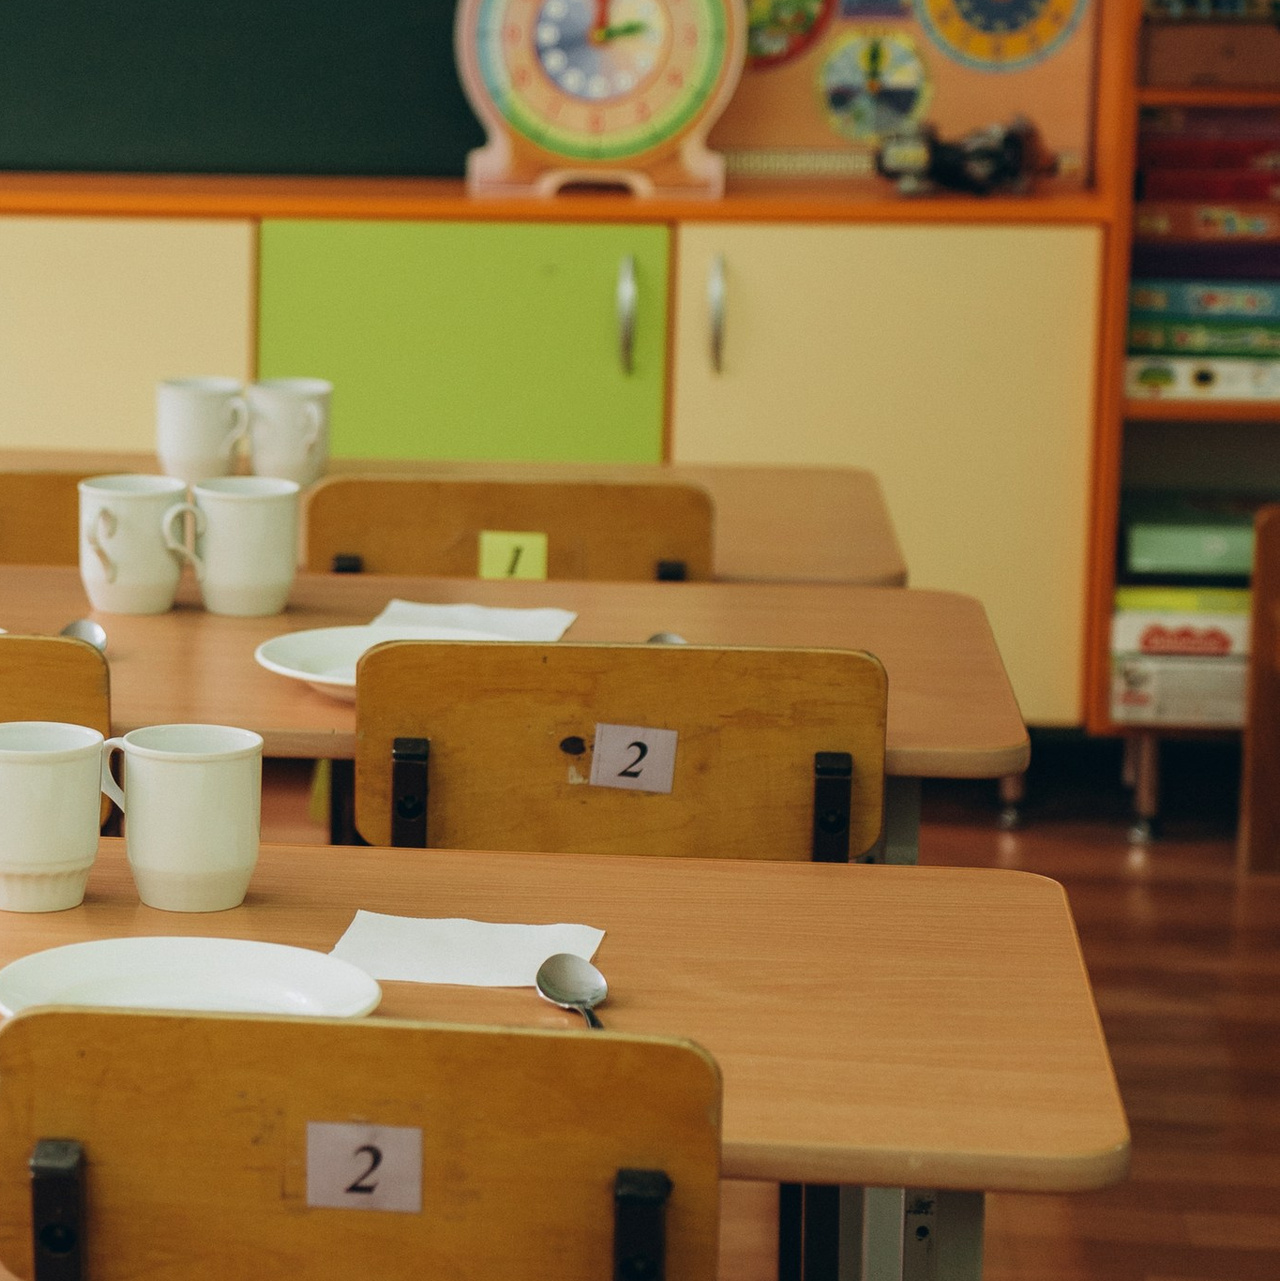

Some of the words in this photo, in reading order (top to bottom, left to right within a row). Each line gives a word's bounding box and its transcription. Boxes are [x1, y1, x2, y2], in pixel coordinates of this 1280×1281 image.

[506, 545, 524, 577] 1
[617, 740, 649, 779] 2
[344, 1144, 383, 1195] 2
